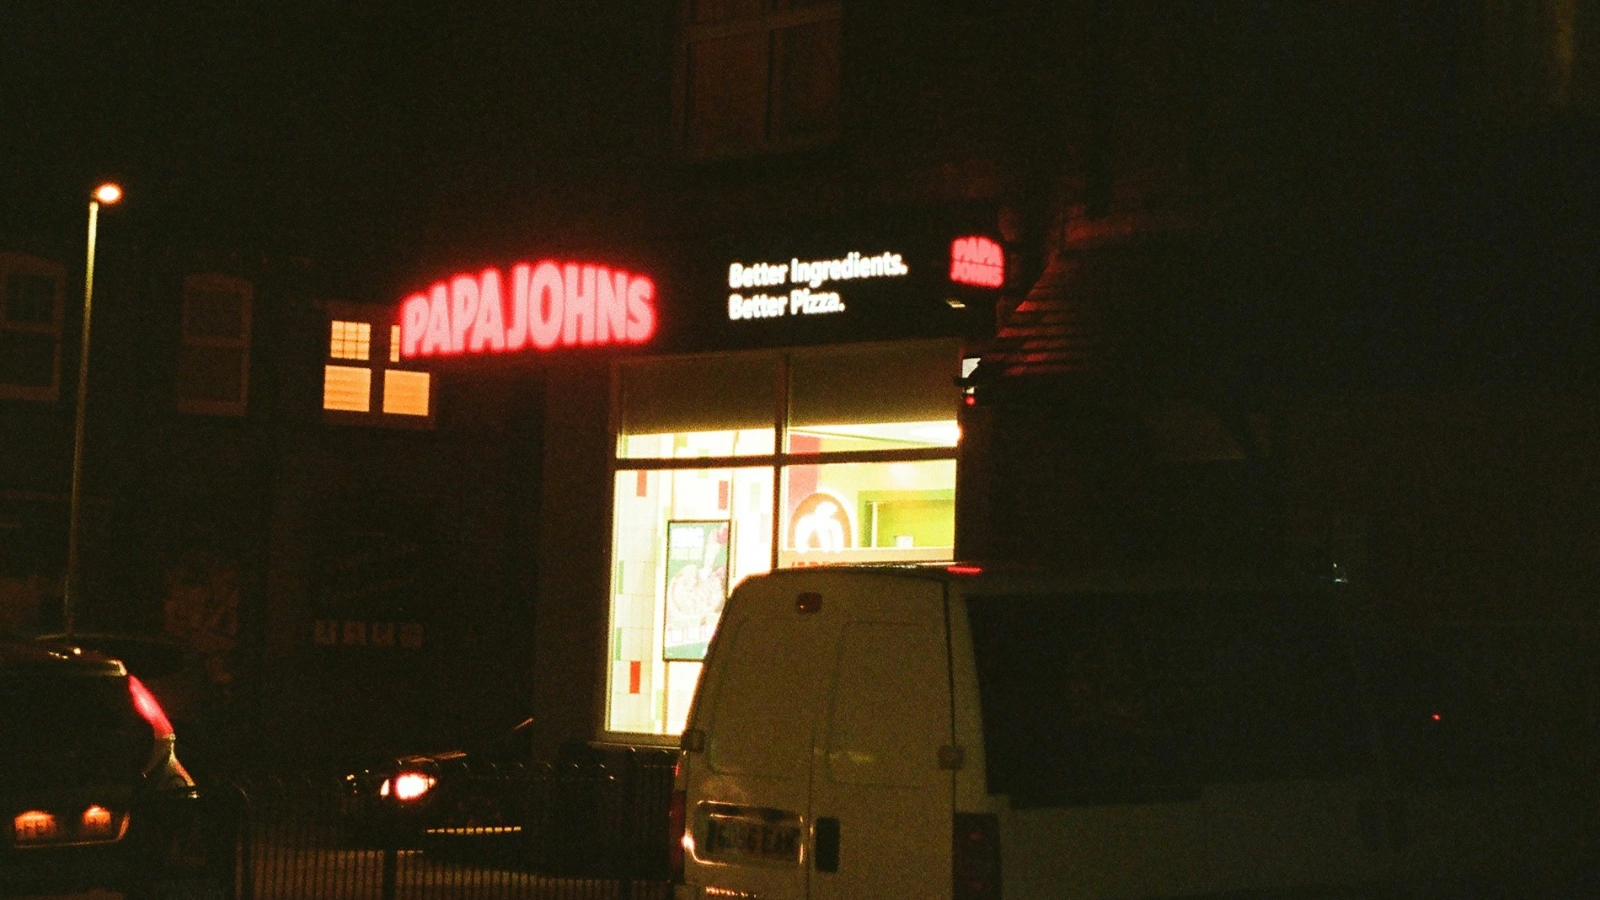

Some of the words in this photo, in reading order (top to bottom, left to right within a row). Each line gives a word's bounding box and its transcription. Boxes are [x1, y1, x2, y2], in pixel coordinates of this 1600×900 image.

[950, 235, 1003, 267] PAPA
[729, 263, 788, 288] Better
[790, 252, 908, 288] Ingredients.
[402, 268, 506, 356] PAPA
[507, 260, 657, 349] JOHNS
[728, 294, 788, 320] Better
[790, 288, 845, 315] Pizza.
